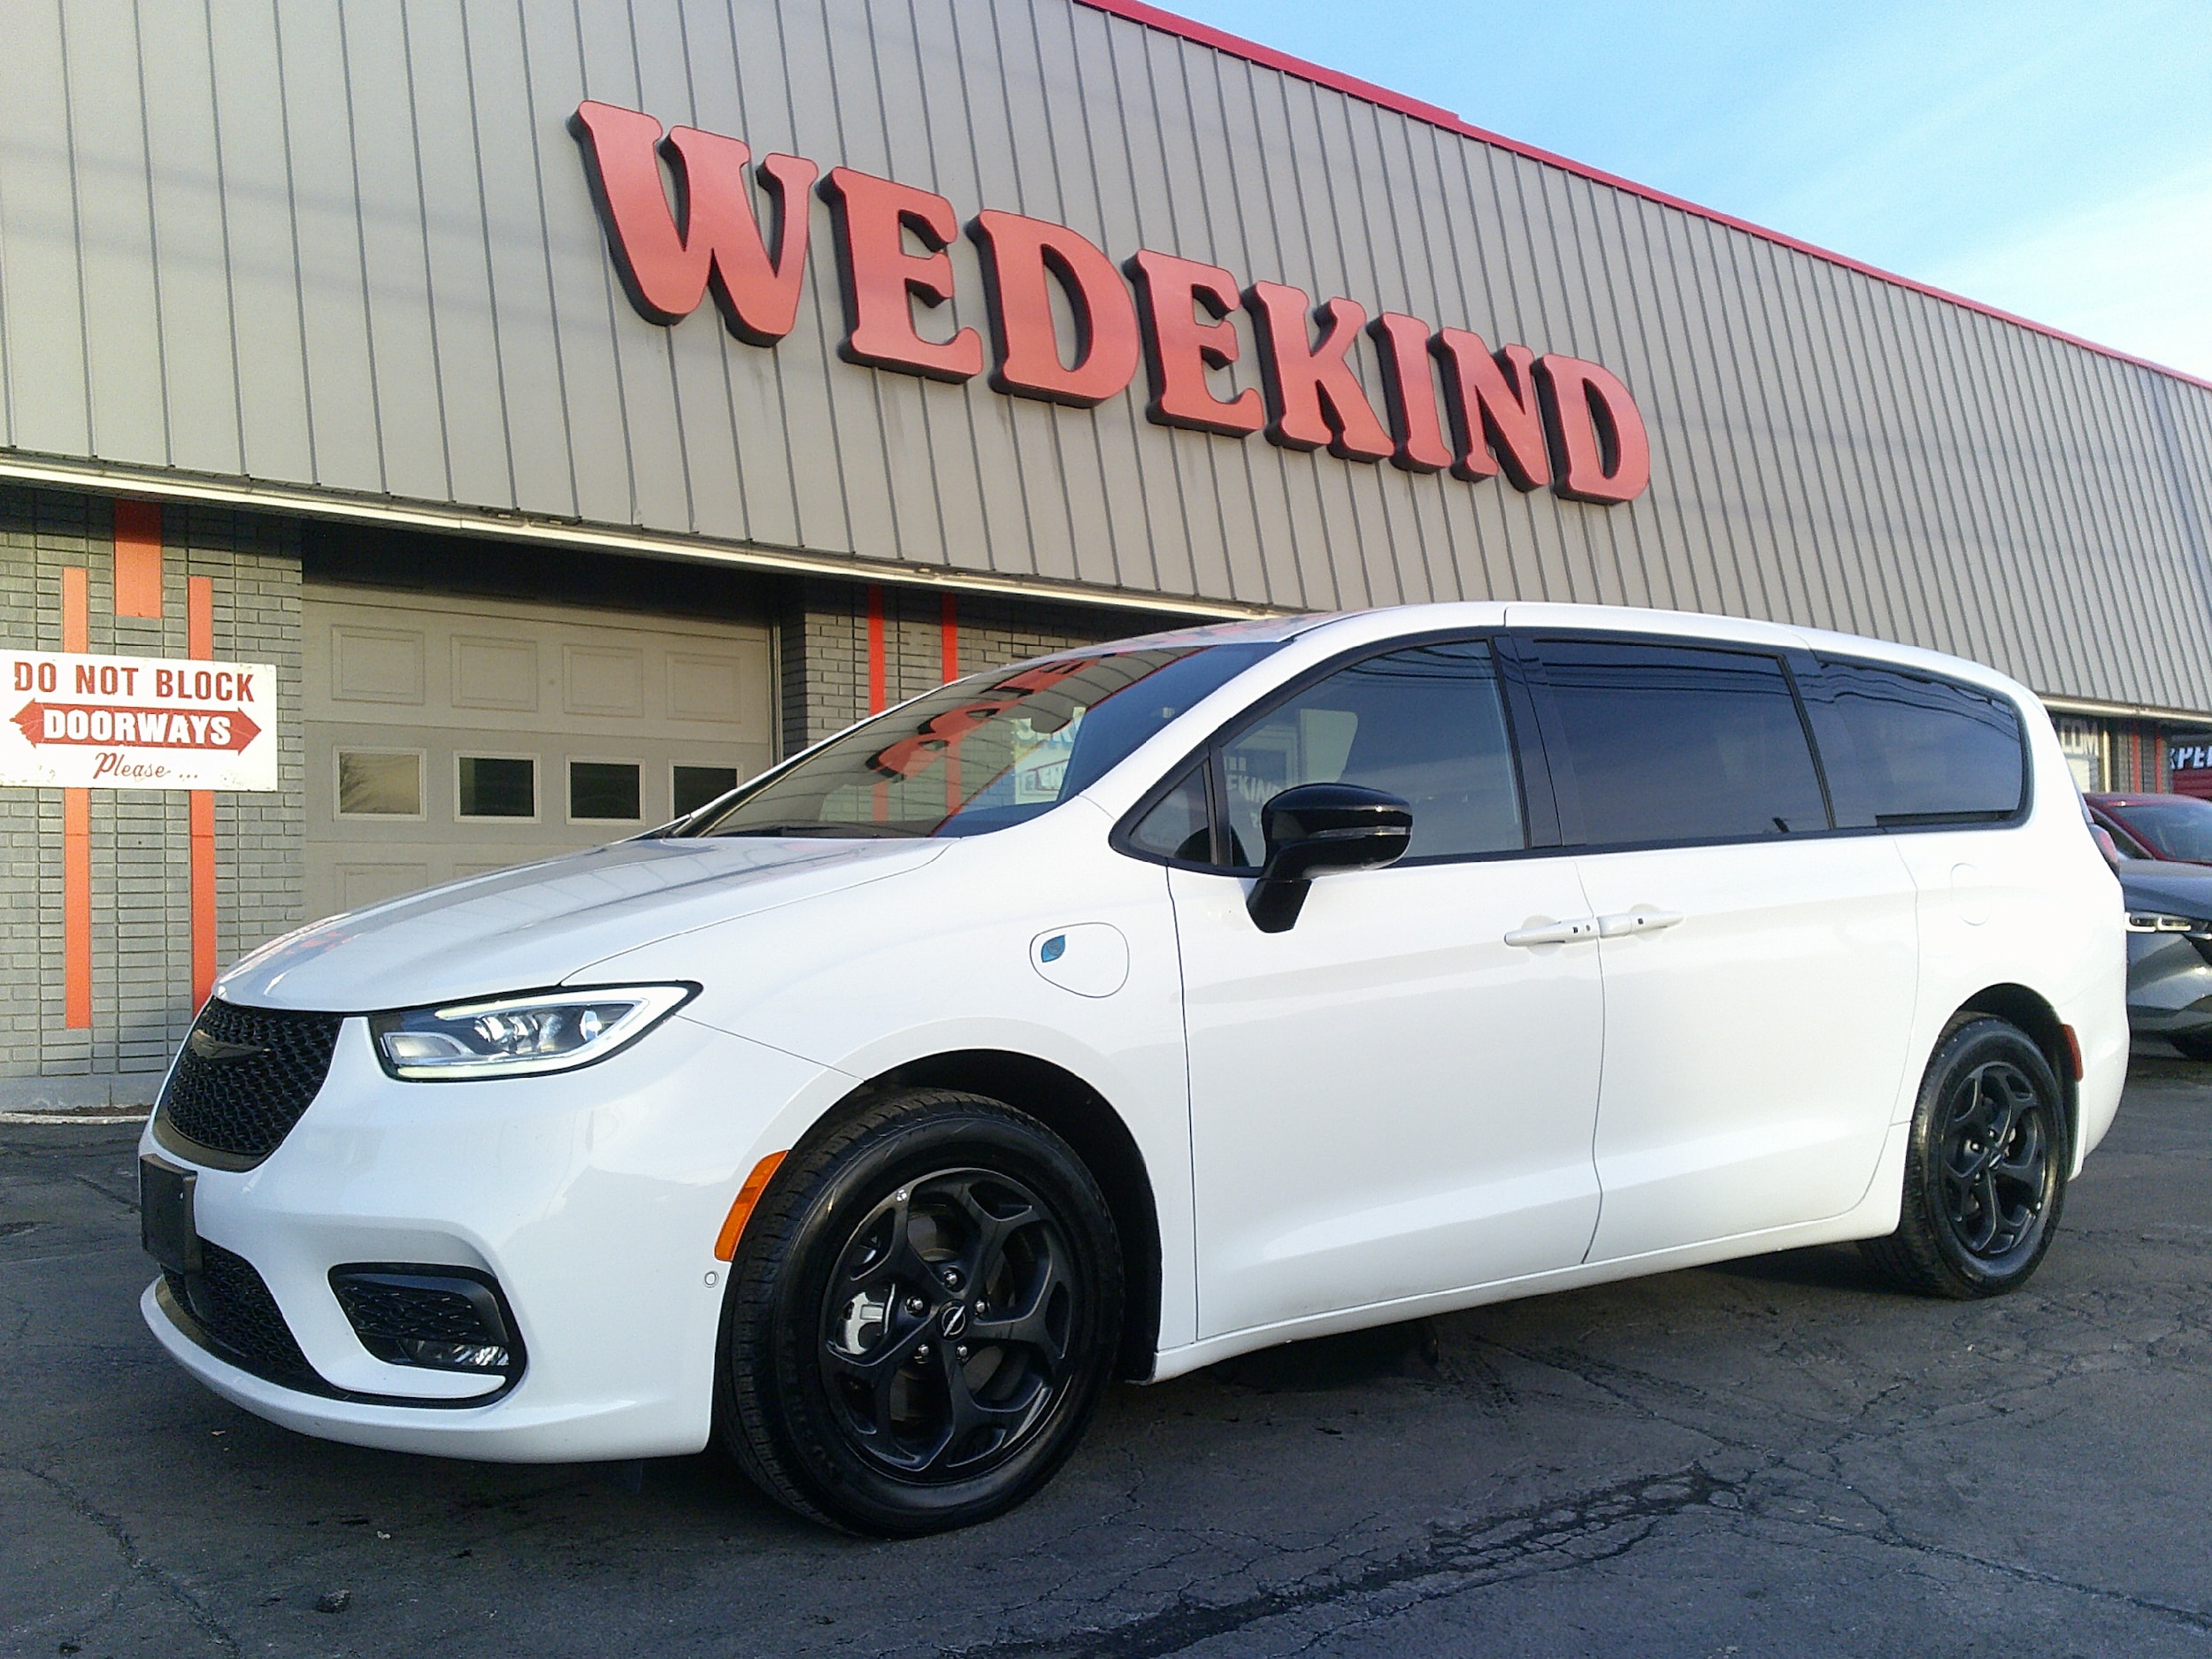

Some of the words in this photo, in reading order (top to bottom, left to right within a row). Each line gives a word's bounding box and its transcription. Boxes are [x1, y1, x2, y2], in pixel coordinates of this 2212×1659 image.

[572, 100, 1651, 503] WEDEKIND
[14, 660, 57, 693] DO
[75, 664, 139, 696] NOT
[156, 669, 255, 703] BLOCK
[43, 708, 232, 746] DOORWAYS
[92, 752, 172, 780] Please
